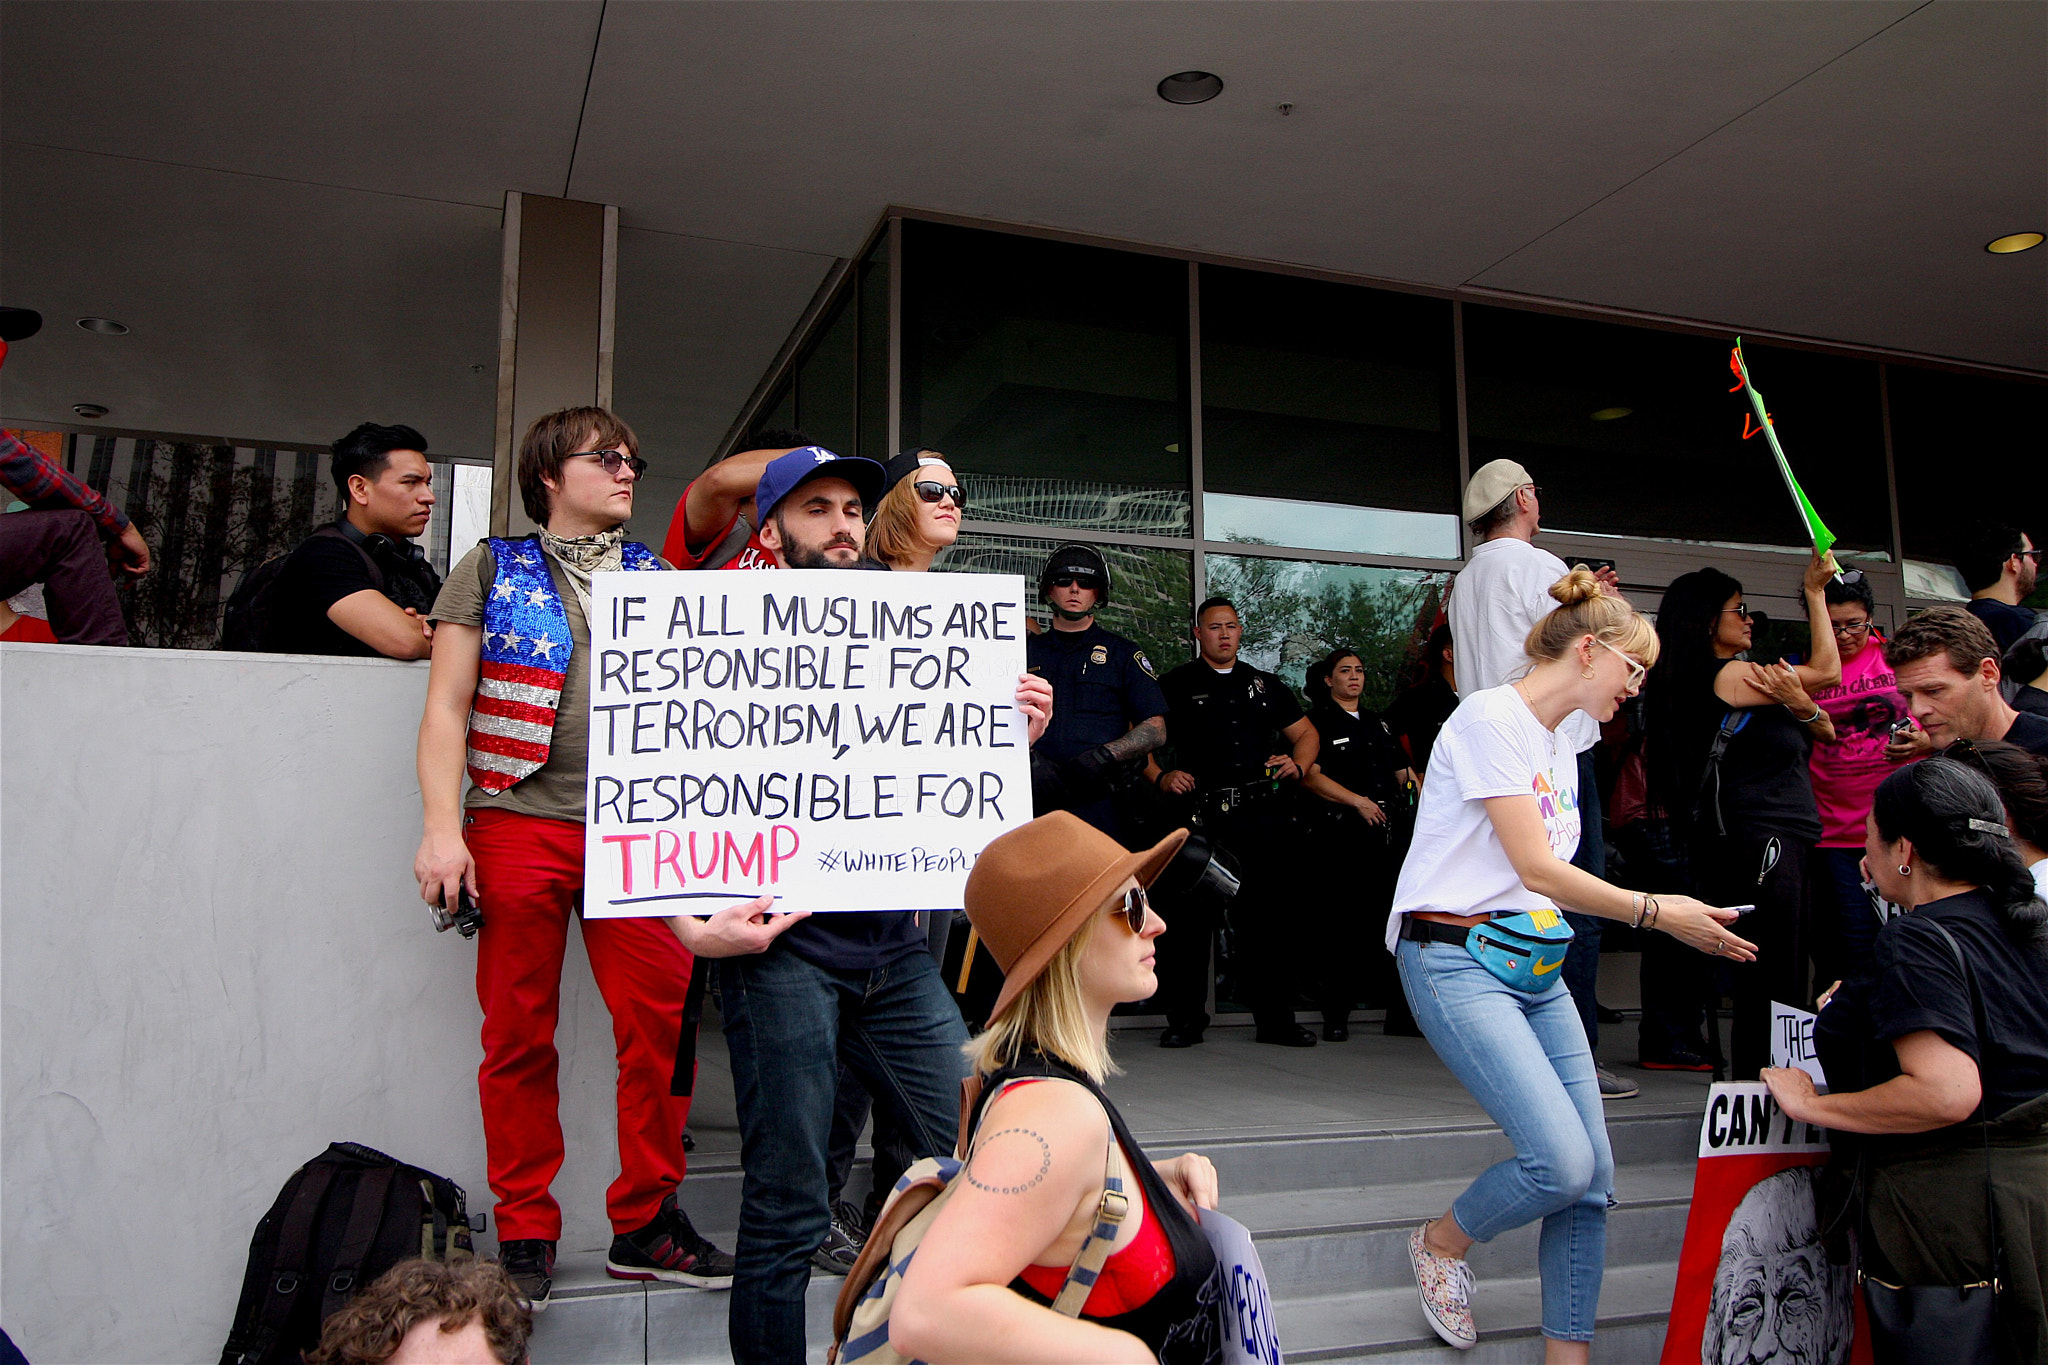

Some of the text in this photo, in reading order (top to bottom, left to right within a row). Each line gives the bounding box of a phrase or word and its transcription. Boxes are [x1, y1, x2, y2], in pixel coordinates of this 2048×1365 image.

[612, 594, 1016, 641] IF ALL MUSLIMS ARE
[600, 645, 972, 695] RESPONSIBLE FOR
[1811, 685, 1847, 701] ERTA
[593, 699, 1015, 760] TERRORISM, WE ARE
[594, 772, 1005, 824] RESPONSIBLE FOR
[602, 825, 800, 895] TRUMP
